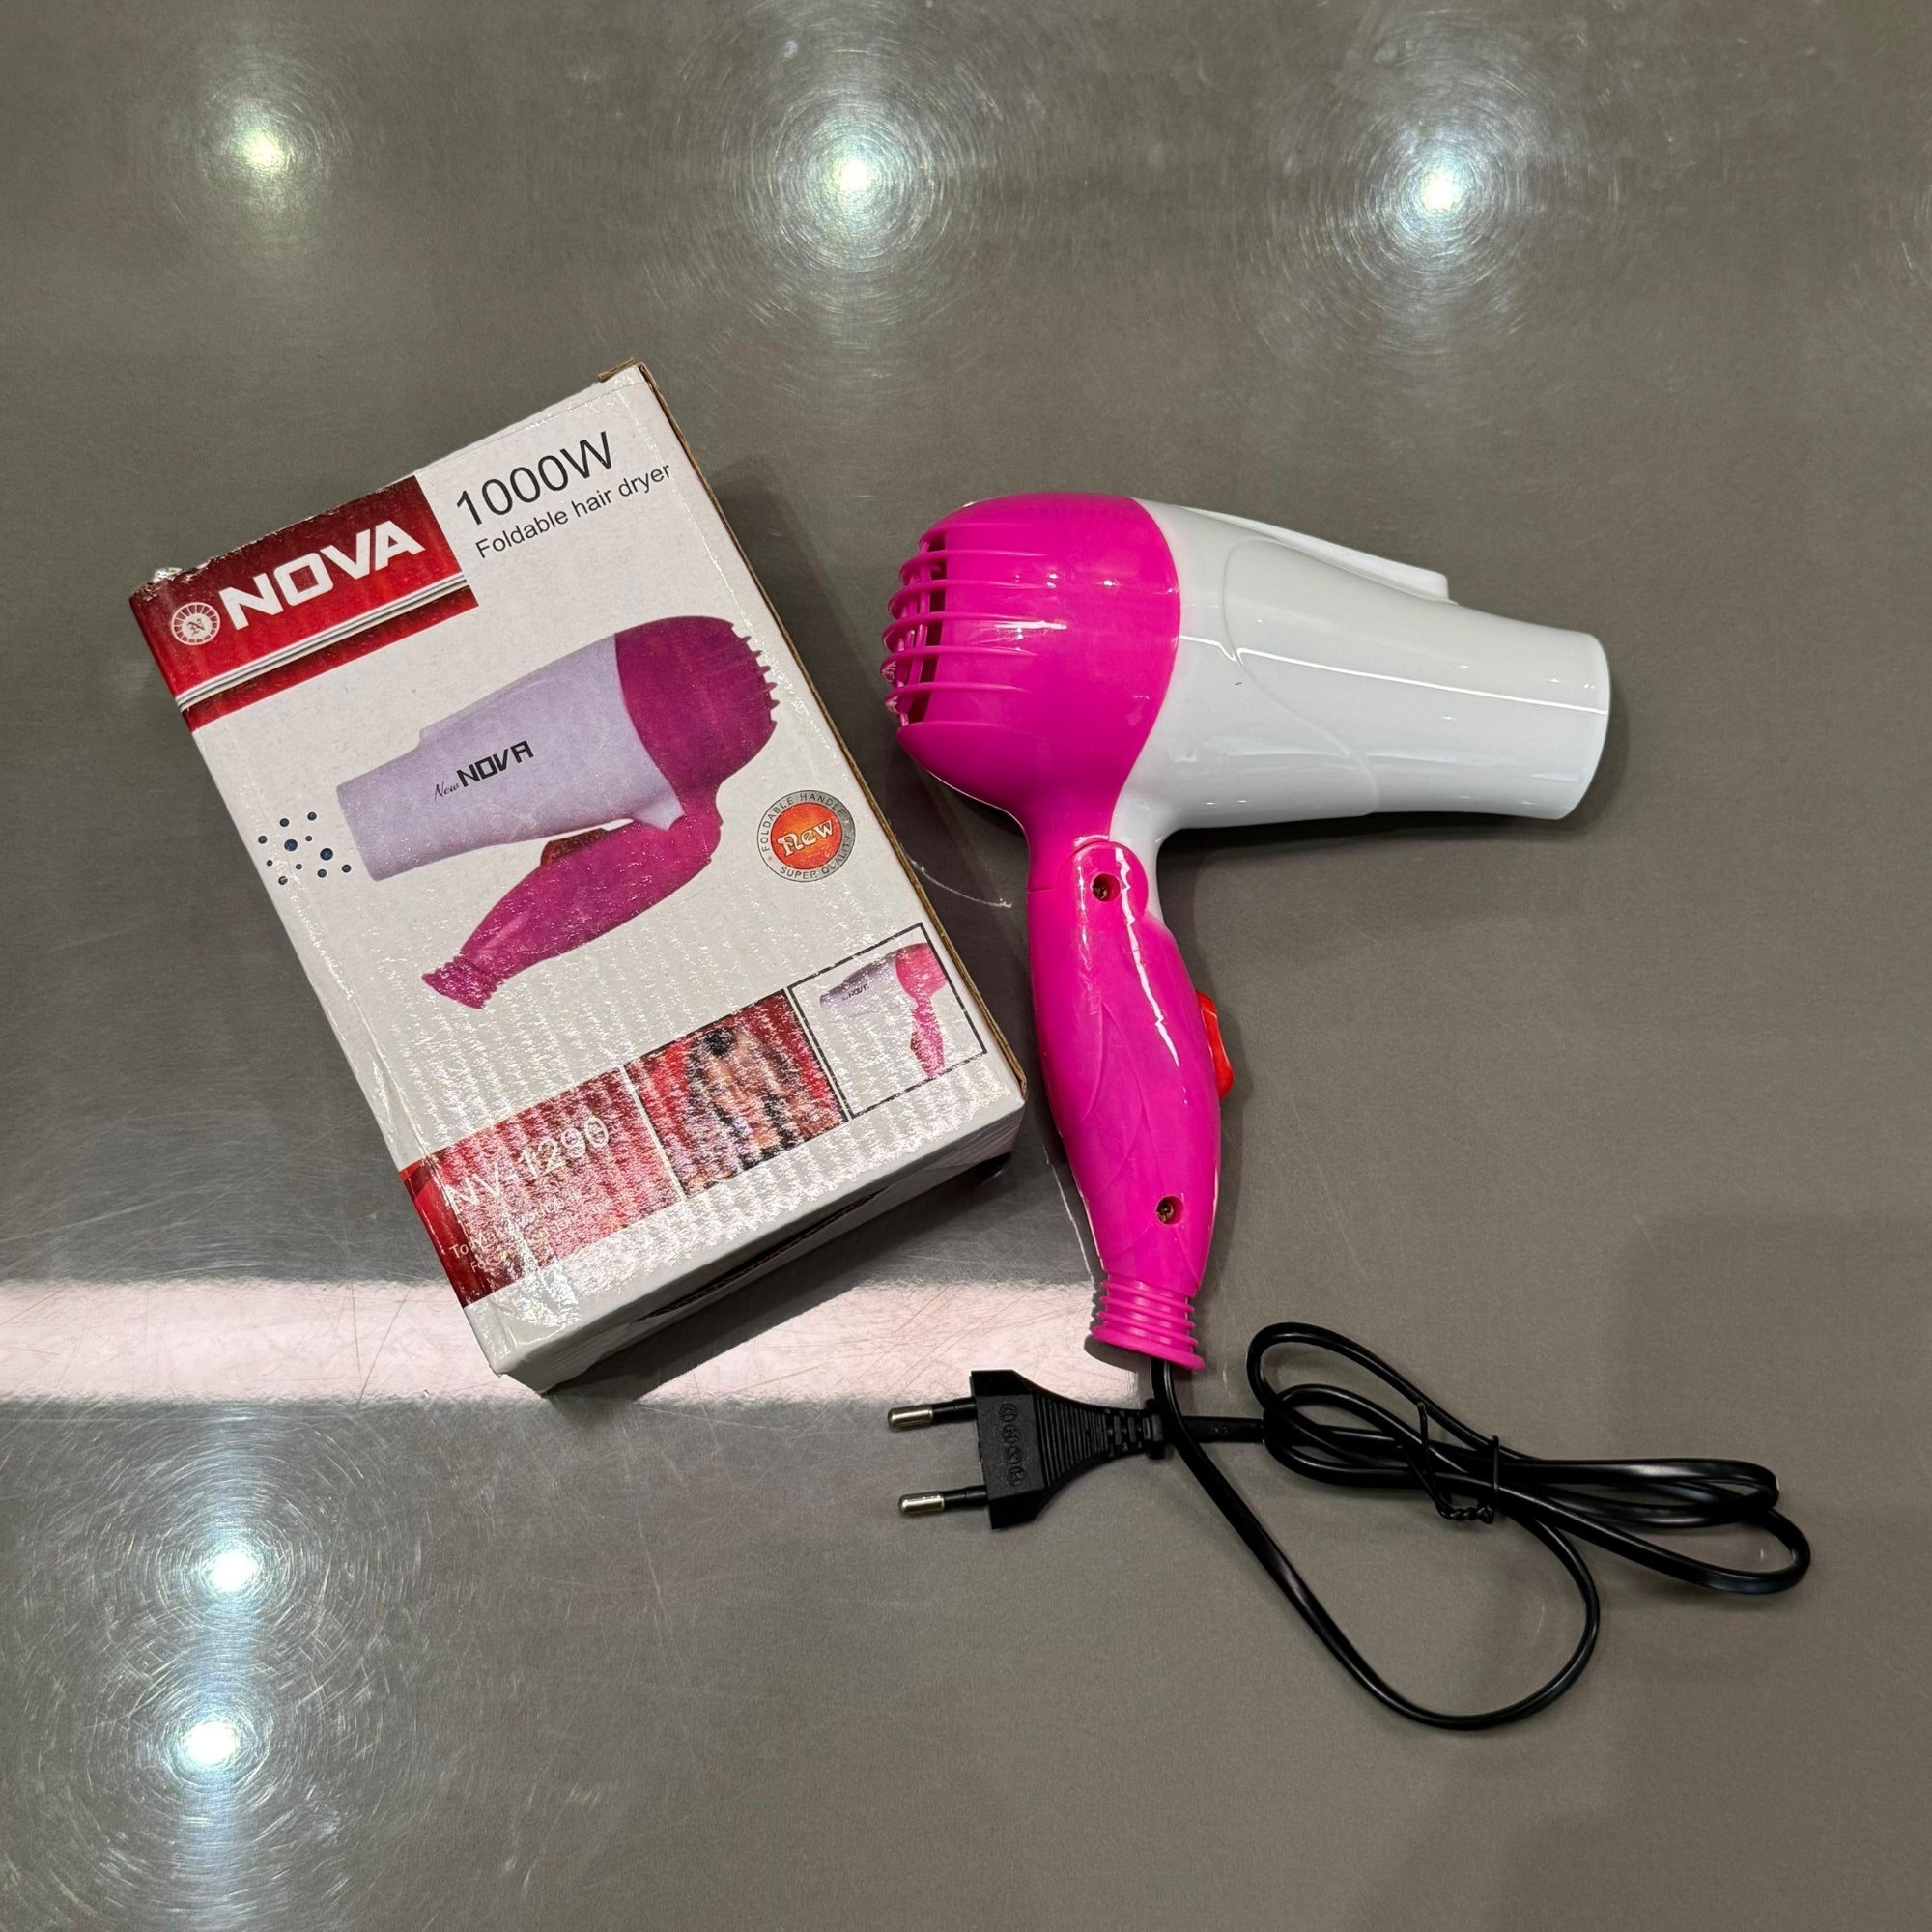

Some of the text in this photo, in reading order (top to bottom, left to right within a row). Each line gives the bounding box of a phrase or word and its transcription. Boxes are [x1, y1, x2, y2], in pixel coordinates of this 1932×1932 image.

[456, 431, 612, 526] 1000W
[475, 464, 671, 558] Foldable hair dryer
[218, 520, 426, 631] NOVA
[434, 740, 534, 804] New NOVA
[760, 793, 847, 852] FOLDABLE HANDLE
[780, 835, 851, 880] SUPER QUALITY
[444, 1116, 610, 1215] NV-1290
[449, 1243, 469, 1259] To
